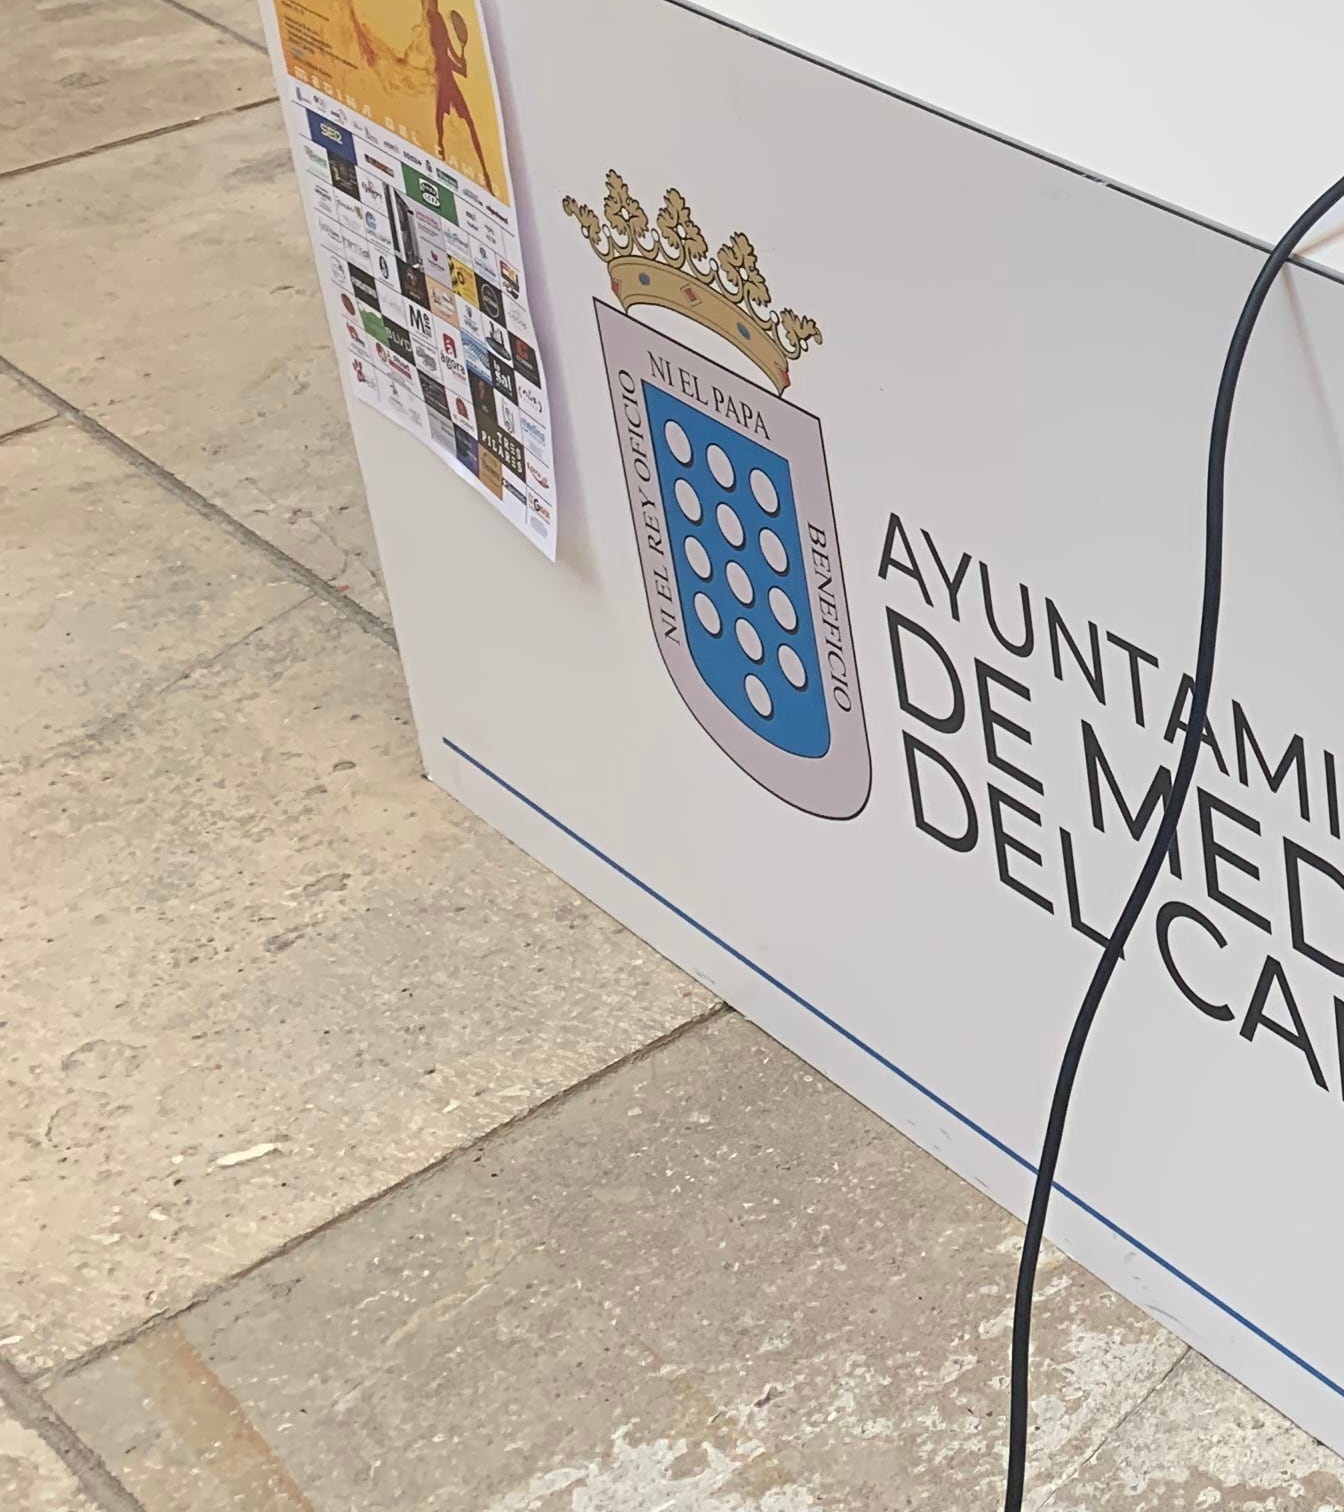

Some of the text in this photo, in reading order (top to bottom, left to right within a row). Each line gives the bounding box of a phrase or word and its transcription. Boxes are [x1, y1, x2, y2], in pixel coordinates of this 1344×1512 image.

[647, 351, 771, 440] NI EL PAPA
[618, 369, 680, 646] NI EL REY OFICIO
[806, 521, 852, 713] BENEFICIO
[886, 606, 1044, 796] DE
[902, 729, 1126, 960] DEL
